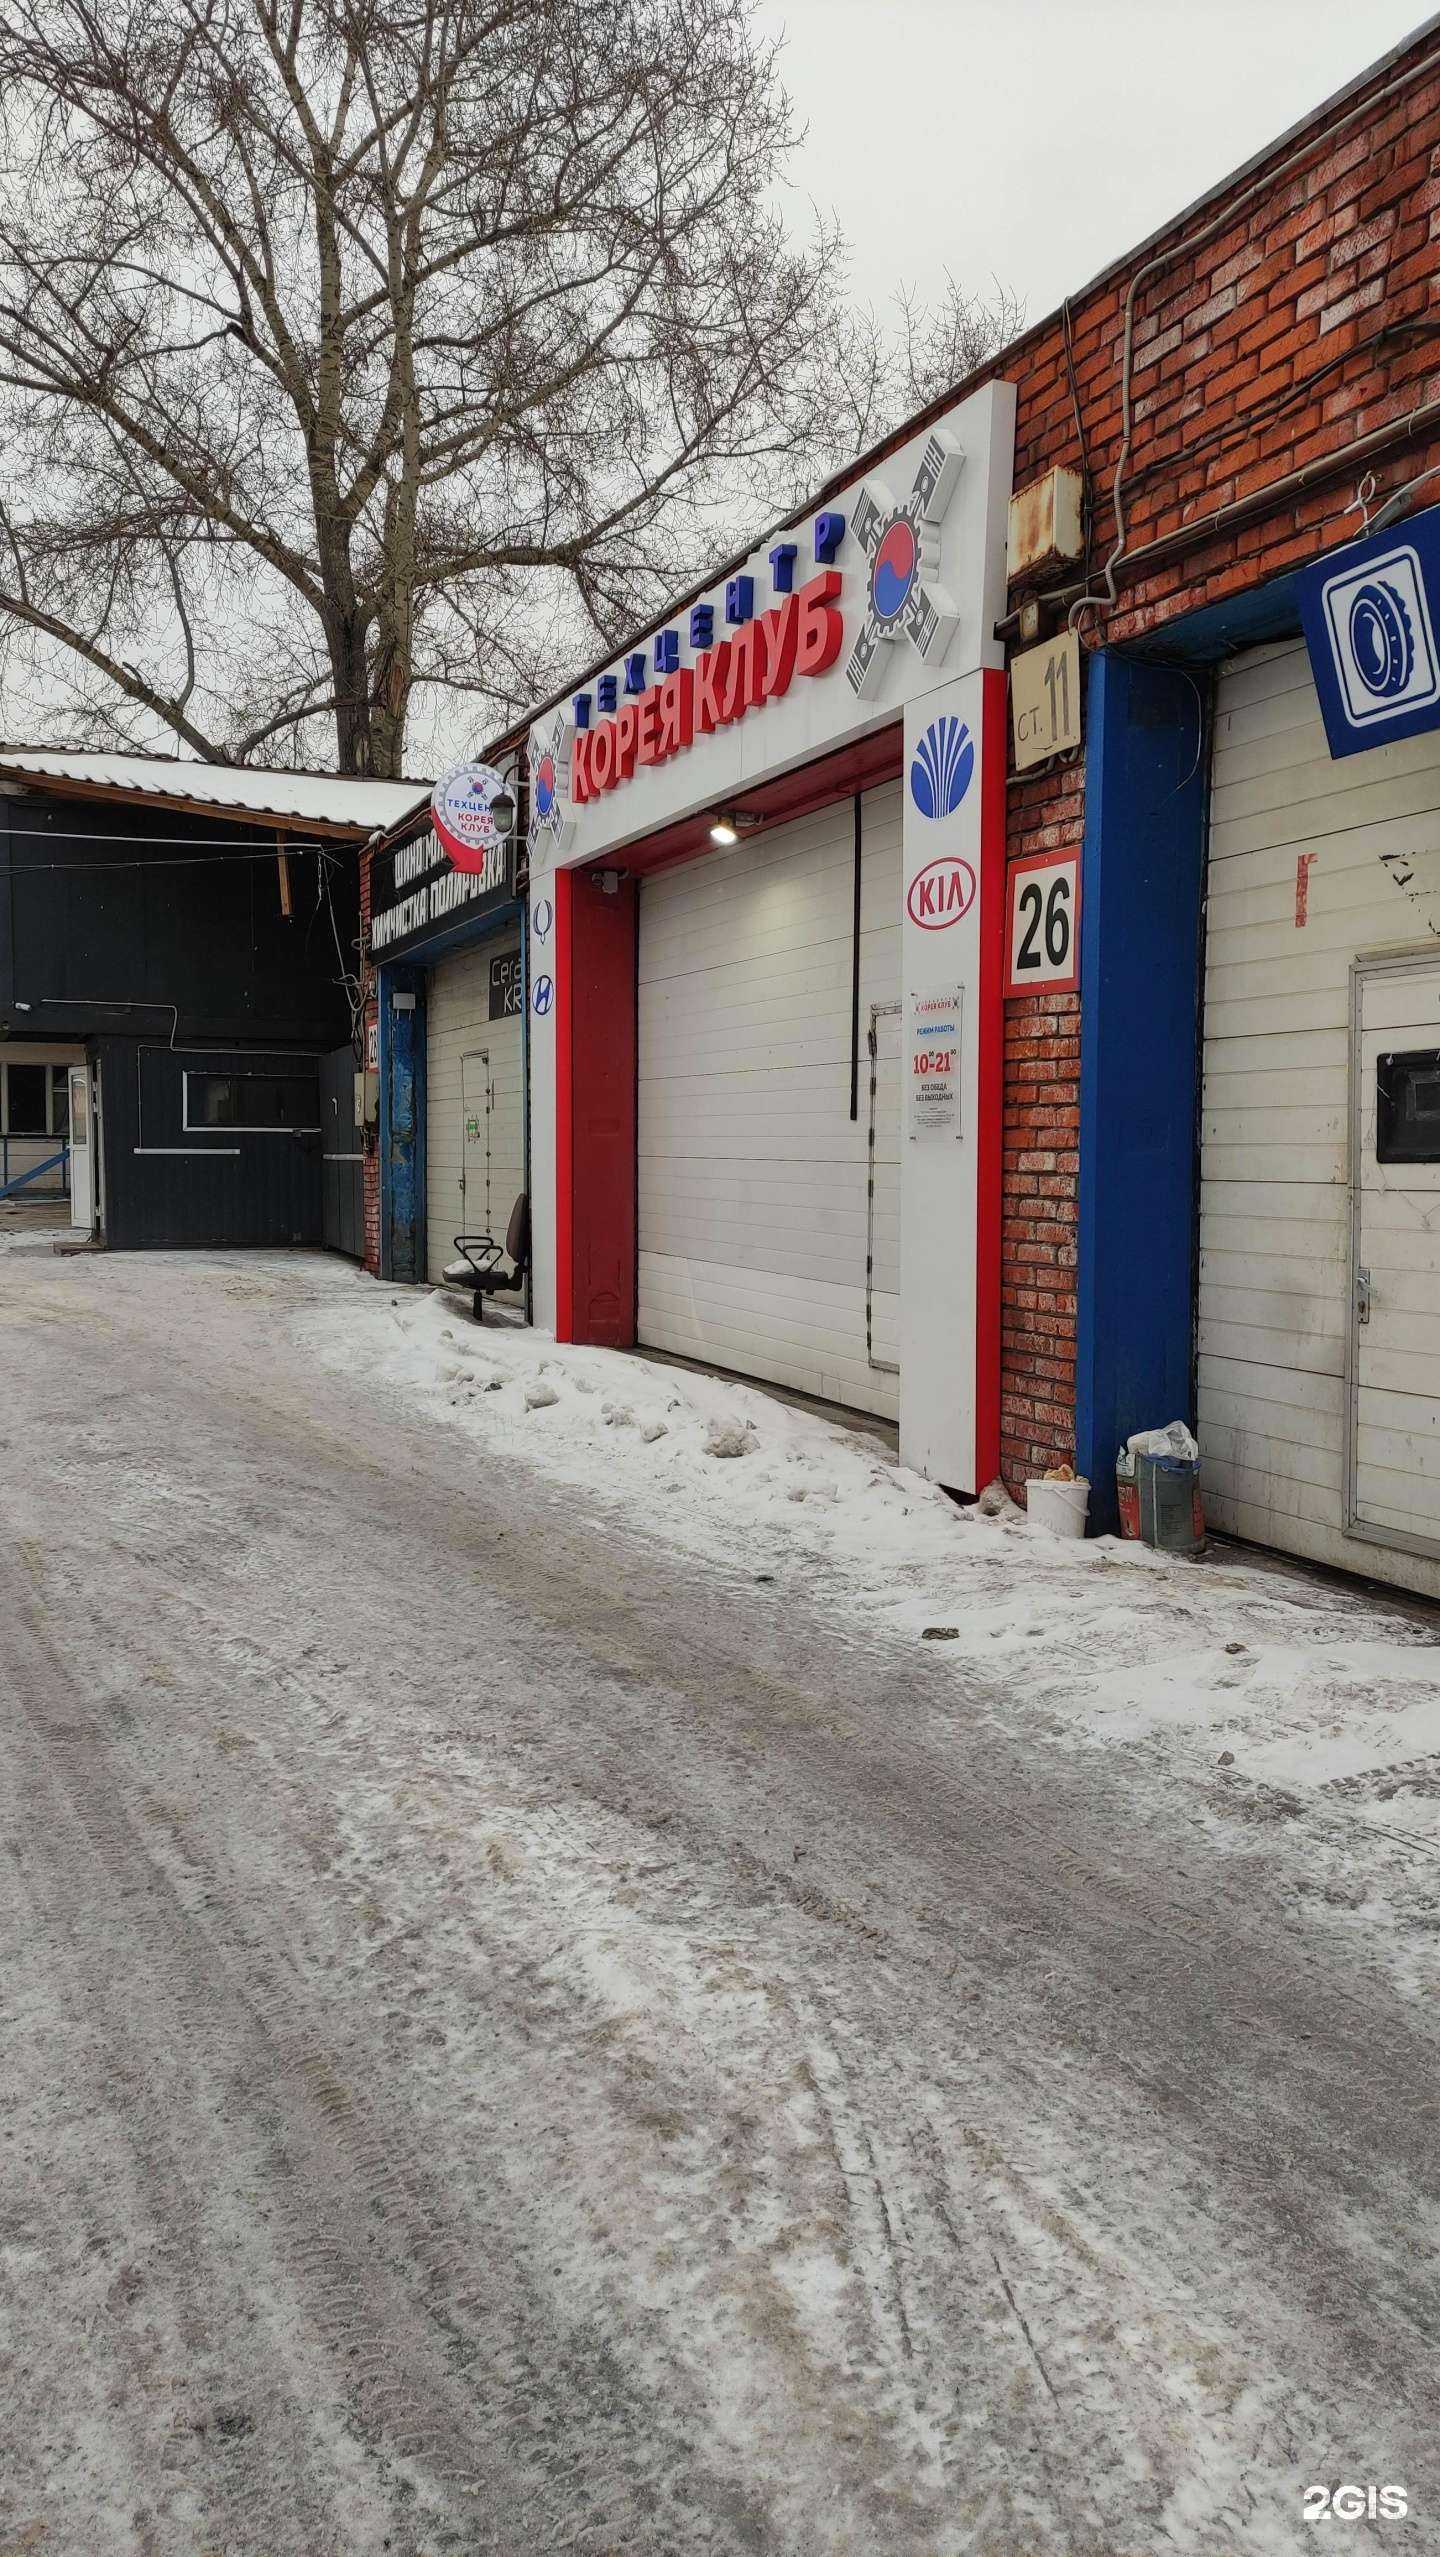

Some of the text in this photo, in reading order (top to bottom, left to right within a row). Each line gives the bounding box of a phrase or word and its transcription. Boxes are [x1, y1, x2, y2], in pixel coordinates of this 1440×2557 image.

[573, 512, 845, 728] ТЕХЦЕНТР
[572, 571, 843, 803] КОРЕЯ КЛУБ
[1044, 651, 1071, 743] 11
[447, 799, 491, 811] ТЕХЦЕН
[458, 813, 494, 825] КОРЕЯ
[461, 823, 490, 833] КЛУБ
[371, 887, 428, 951] ХИМЧИСТКА
[918, 870, 965, 917] KIA
[1016, 876, 1071, 970] 26
